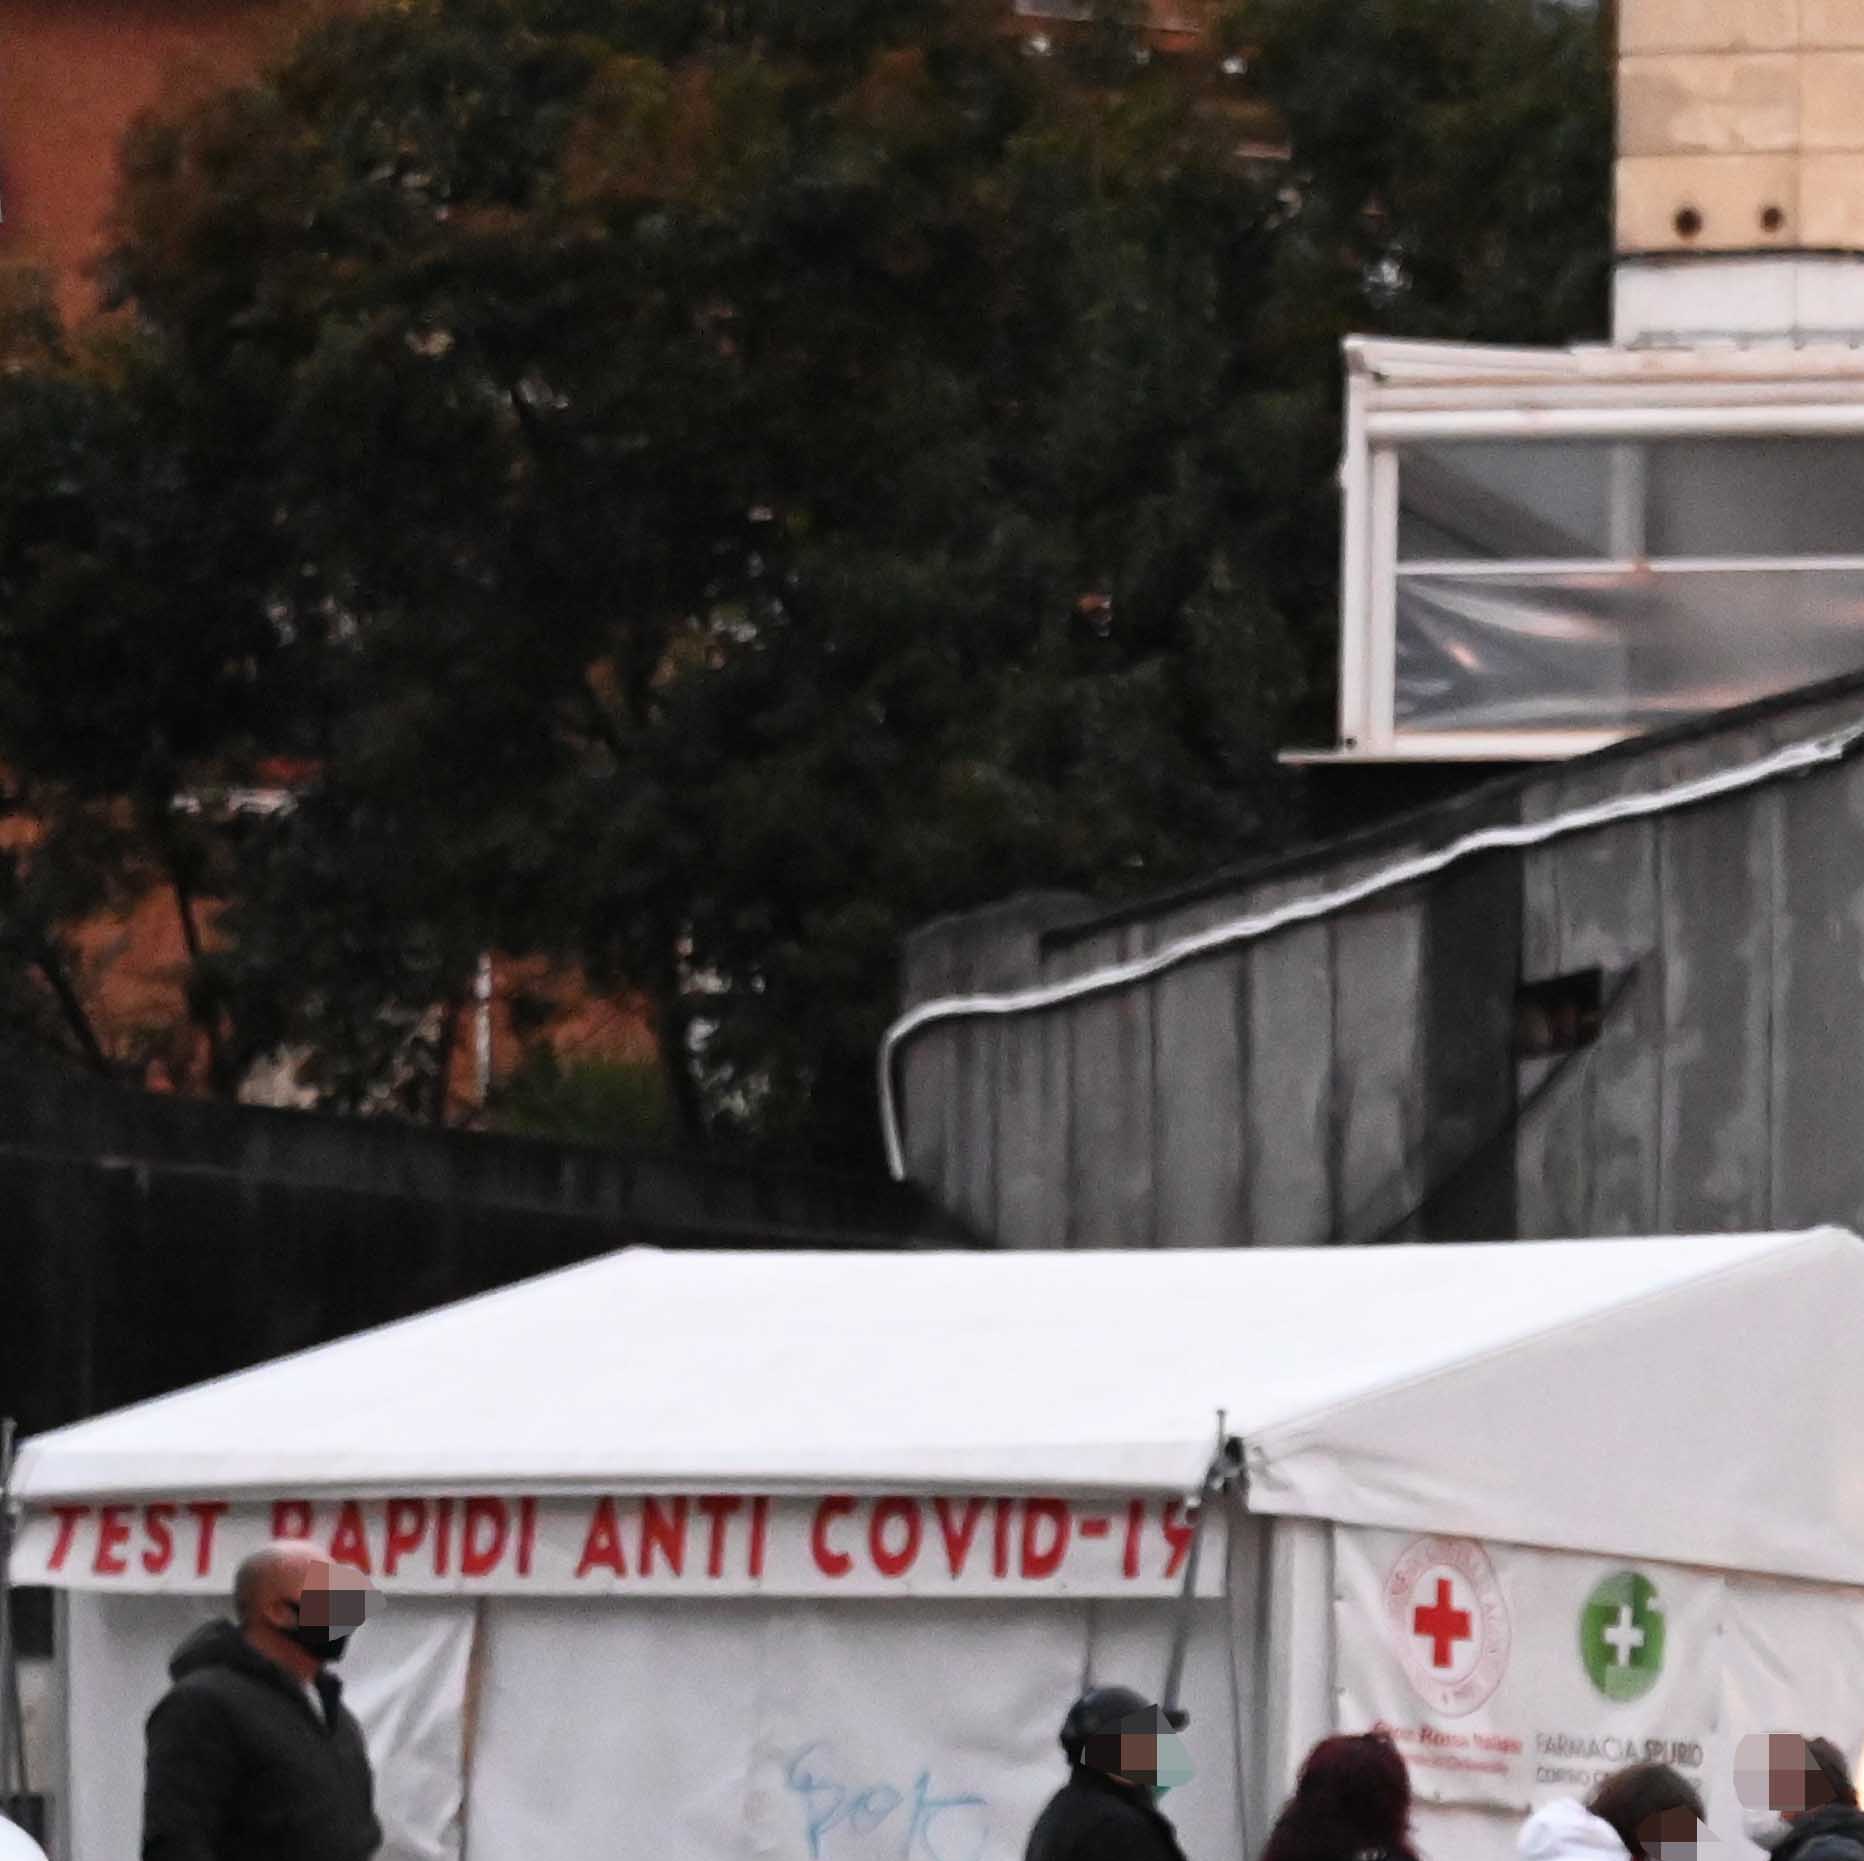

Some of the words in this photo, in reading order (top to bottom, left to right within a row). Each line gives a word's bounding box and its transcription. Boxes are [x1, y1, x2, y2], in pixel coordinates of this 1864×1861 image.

[46, 1502, 229, 1577] TEST
[577, 1495, 768, 1578] ANTI
[811, 1494, 1200, 1580] COVID-19
[1535, 1731, 1641, 1763] FARMACIA
